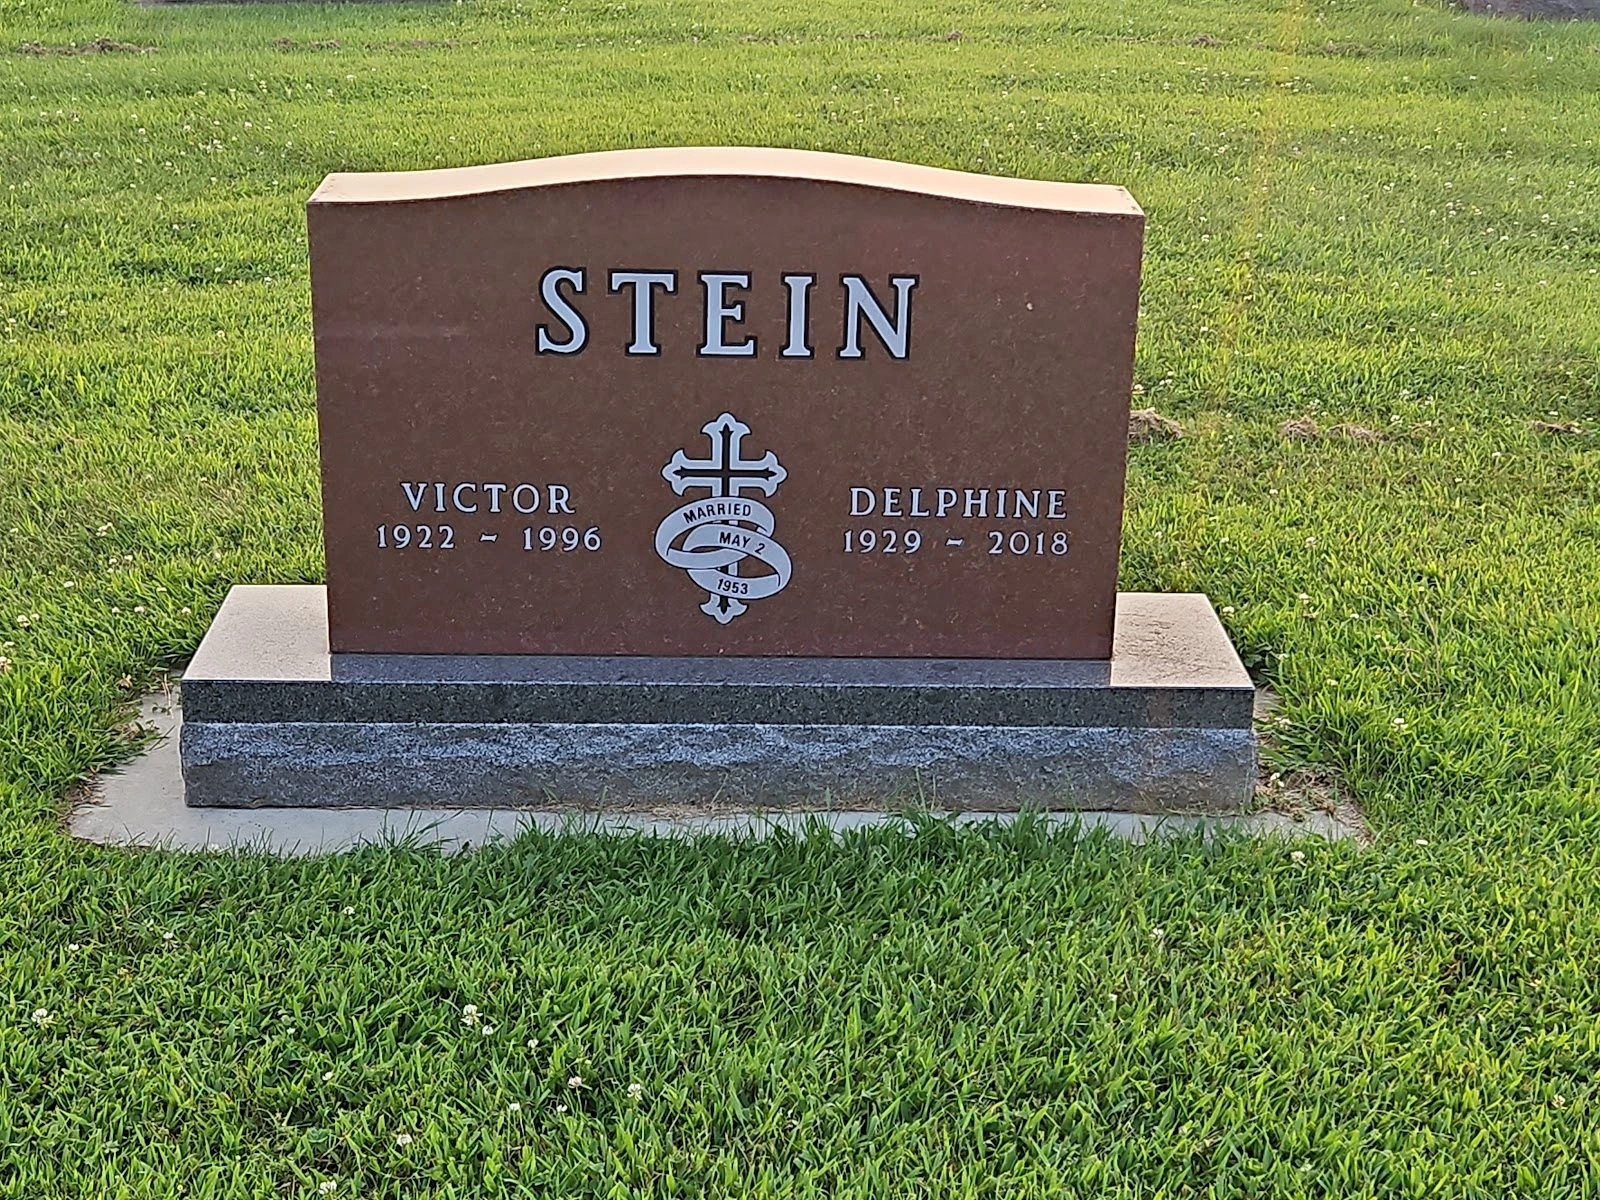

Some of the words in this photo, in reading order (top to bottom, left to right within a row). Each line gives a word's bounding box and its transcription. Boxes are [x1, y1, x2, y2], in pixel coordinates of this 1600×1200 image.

[536, 266, 919, 360] STEIN
[400, 482, 576, 514] VICTOR
[849, 487, 1067, 518] DELPHINE
[683, 503, 751, 524] MARRIED
[376, 524, 456, 549] 1922
[523, 526, 602, 552] 1996
[719, 532, 751, 548] MAY
[754, 543, 766, 555] 2
[843, 529, 922, 554] 1929
[988, 531, 1068, 555] 2018
[717, 578, 748, 595] 1953
